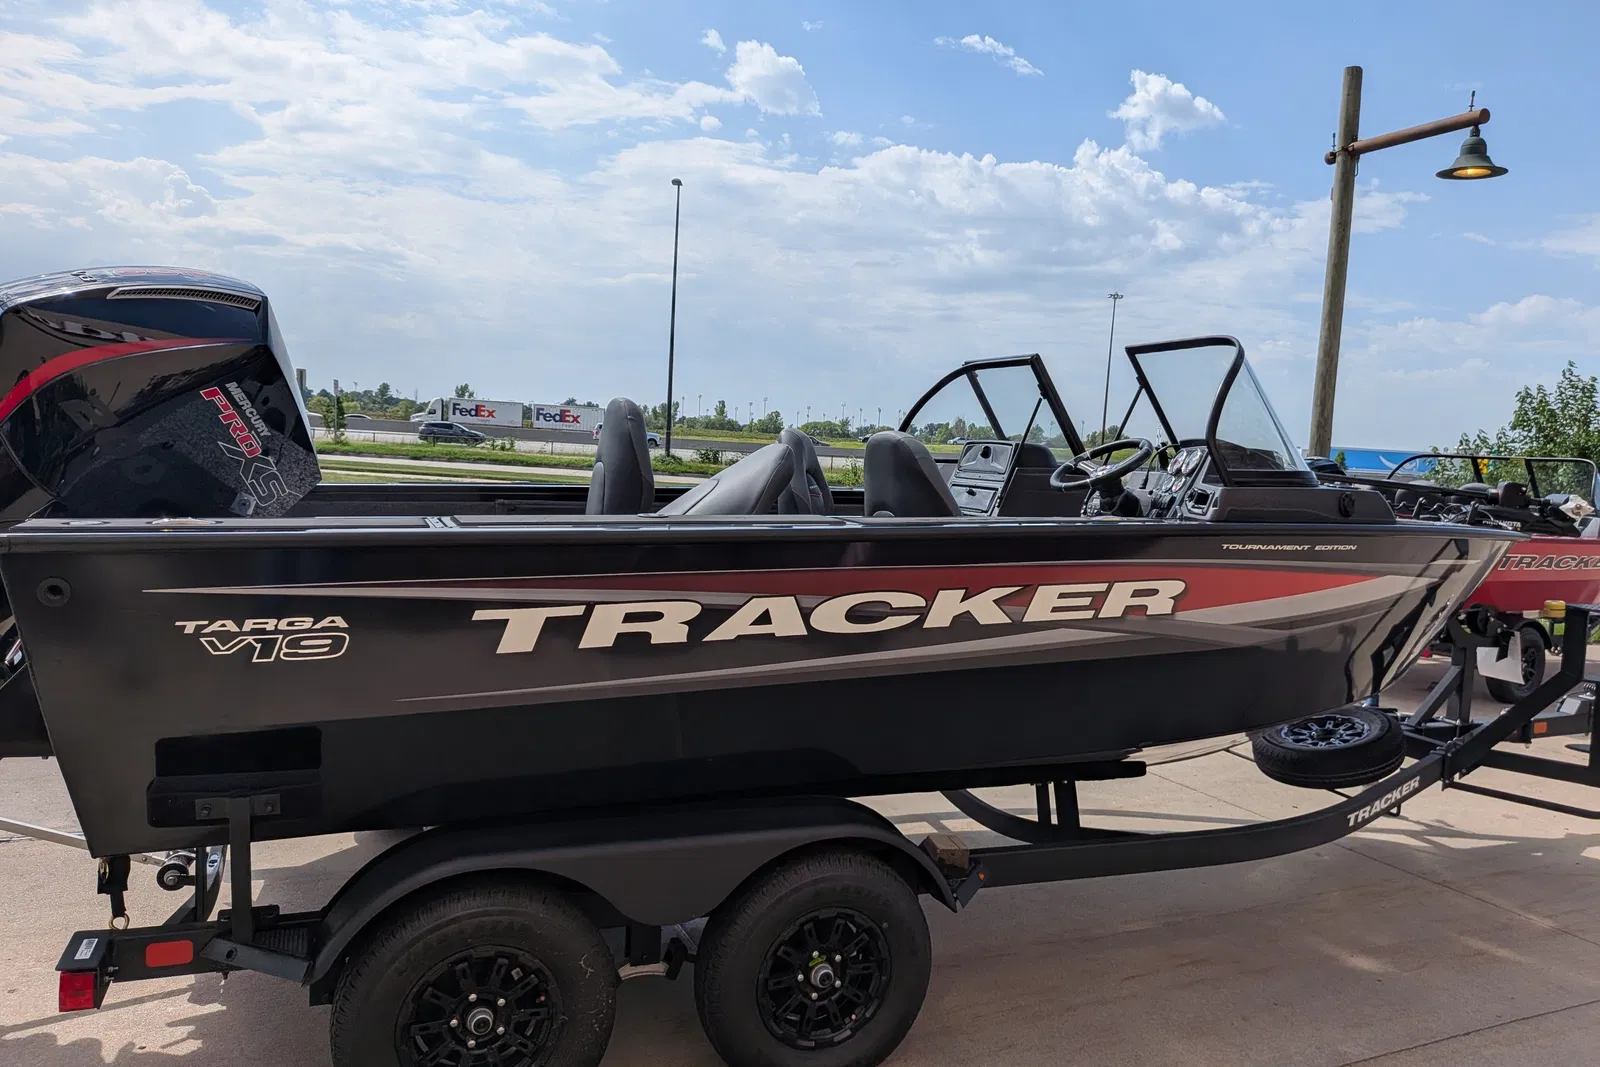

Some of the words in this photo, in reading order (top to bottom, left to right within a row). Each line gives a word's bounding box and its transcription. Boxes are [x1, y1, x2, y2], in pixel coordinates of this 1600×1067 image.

[200, 386, 262, 458] PRO
[225, 381, 271, 437] MERCURY
[452, 402, 496, 419] FedEx
[535, 407, 581, 425] FedEx
[218, 431, 288, 506] XS
[1221, 543, 1311, 551] TOURNAMENT
[175, 615, 350, 634] TARGA
[471, 579, 1187, 655] TRACKER
[199, 632, 349, 663] V19
[1347, 775, 1420, 827] TRACKER
